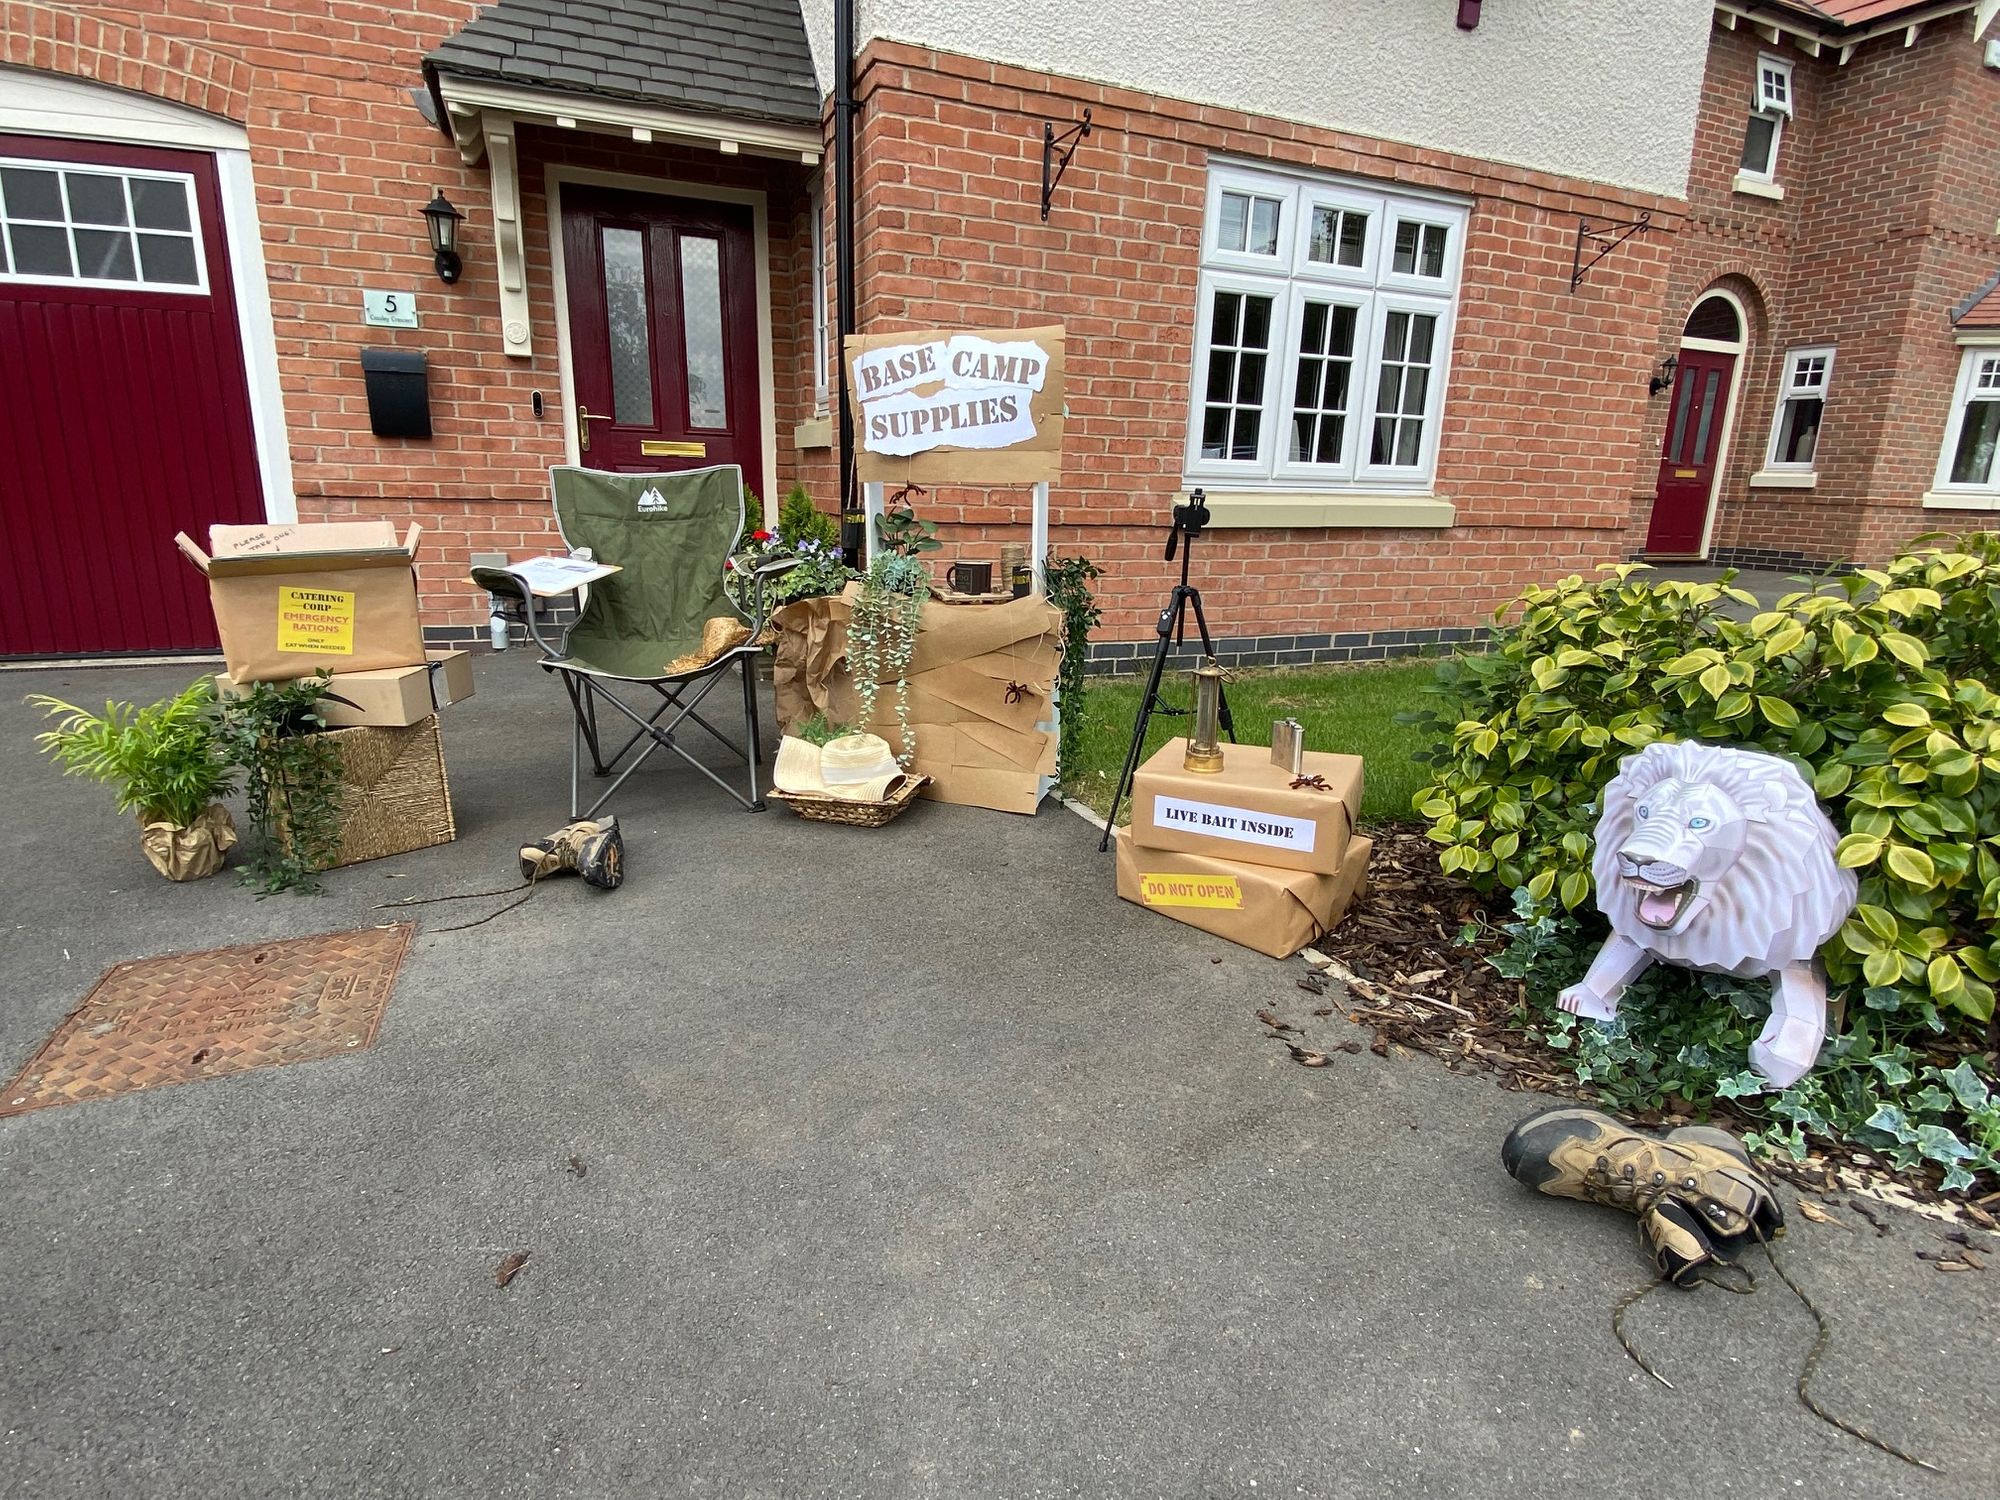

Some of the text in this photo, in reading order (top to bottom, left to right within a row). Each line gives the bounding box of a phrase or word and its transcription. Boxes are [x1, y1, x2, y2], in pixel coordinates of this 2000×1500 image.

[384, 294, 397, 313] 5
[861, 346, 1041, 393] BASE CAMP
[871, 395, 1018, 441] SUPPLIES
[637, 505, 668, 513] Eurohike
[233, 532, 265, 550] PLEASE
[248, 540, 271, 551] TAKE
[290, 591, 345, 603] CATERING
[302, 602, 332, 612] CORP
[283, 612, 349, 624] EMERGENCY
[292, 623, 340, 633] RATIONS
[1166, 807, 1294, 839] LIVE BAIT INSIDE
[1148, 882, 1235, 899] DO NOT OPEN
